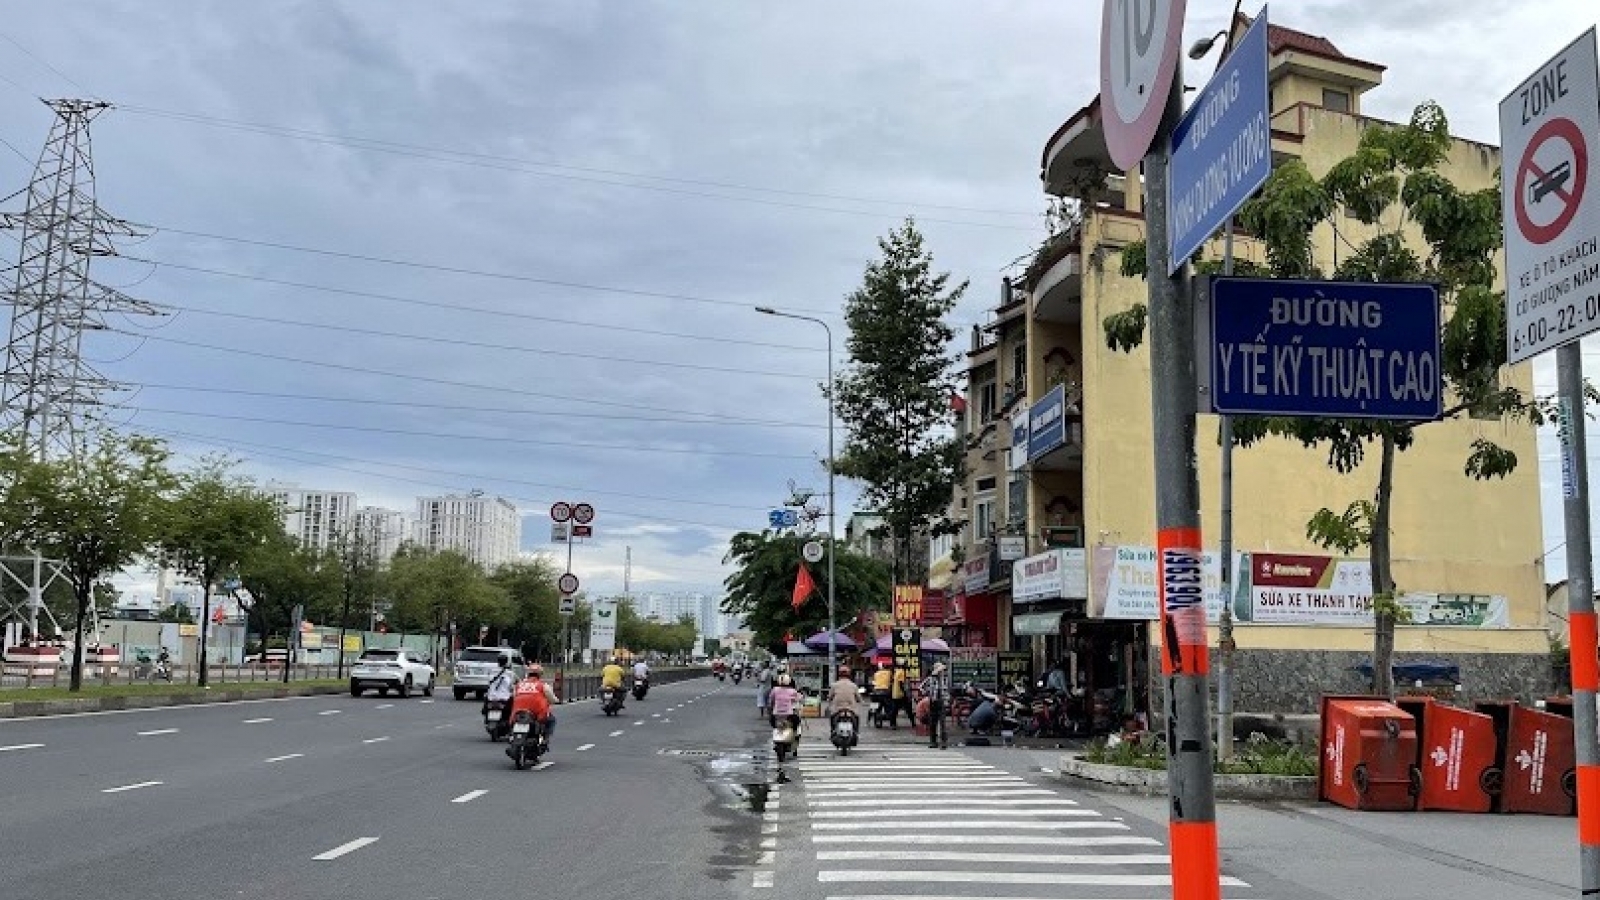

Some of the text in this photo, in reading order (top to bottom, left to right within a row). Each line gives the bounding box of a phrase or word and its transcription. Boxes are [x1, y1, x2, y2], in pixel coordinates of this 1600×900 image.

[1192, 68, 1240, 150] ĐƯỜNG
[1520, 58, 1569, 125] ZONE
[1560, 236, 1597, 268] KHÁCH
[1269, 289, 1383, 328] ĐƯỜNG
[1513, 294, 1600, 353] 6:00-22:0
[1219, 322, 1435, 410] Y TẾ KỸ THUẬT CAO
[1260, 588, 1284, 606] SỬA
[1288, 592, 1302, 606] XE
[1306, 593, 1345, 608] THANH
